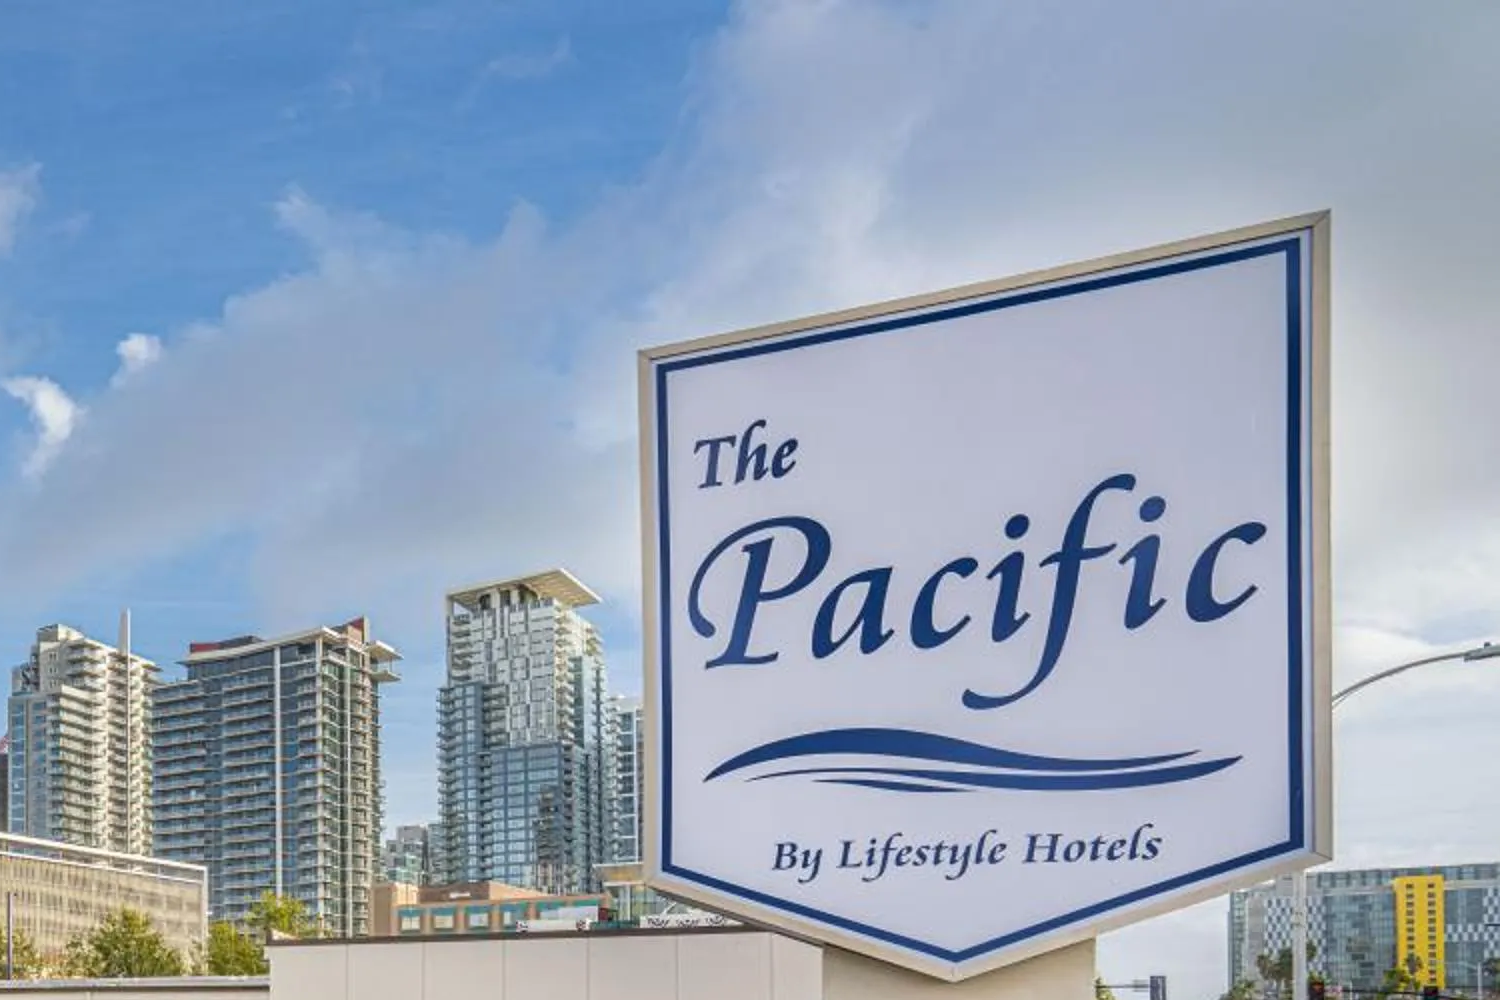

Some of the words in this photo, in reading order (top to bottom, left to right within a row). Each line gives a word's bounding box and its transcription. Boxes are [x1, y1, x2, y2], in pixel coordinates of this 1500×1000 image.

[693, 418, 800, 490] The
[687, 472, 1268, 711] Pacific
[771, 840, 824, 884] By
[835, 829, 1008, 883] Lifestyle
[1021, 823, 1164, 864] Hotels
